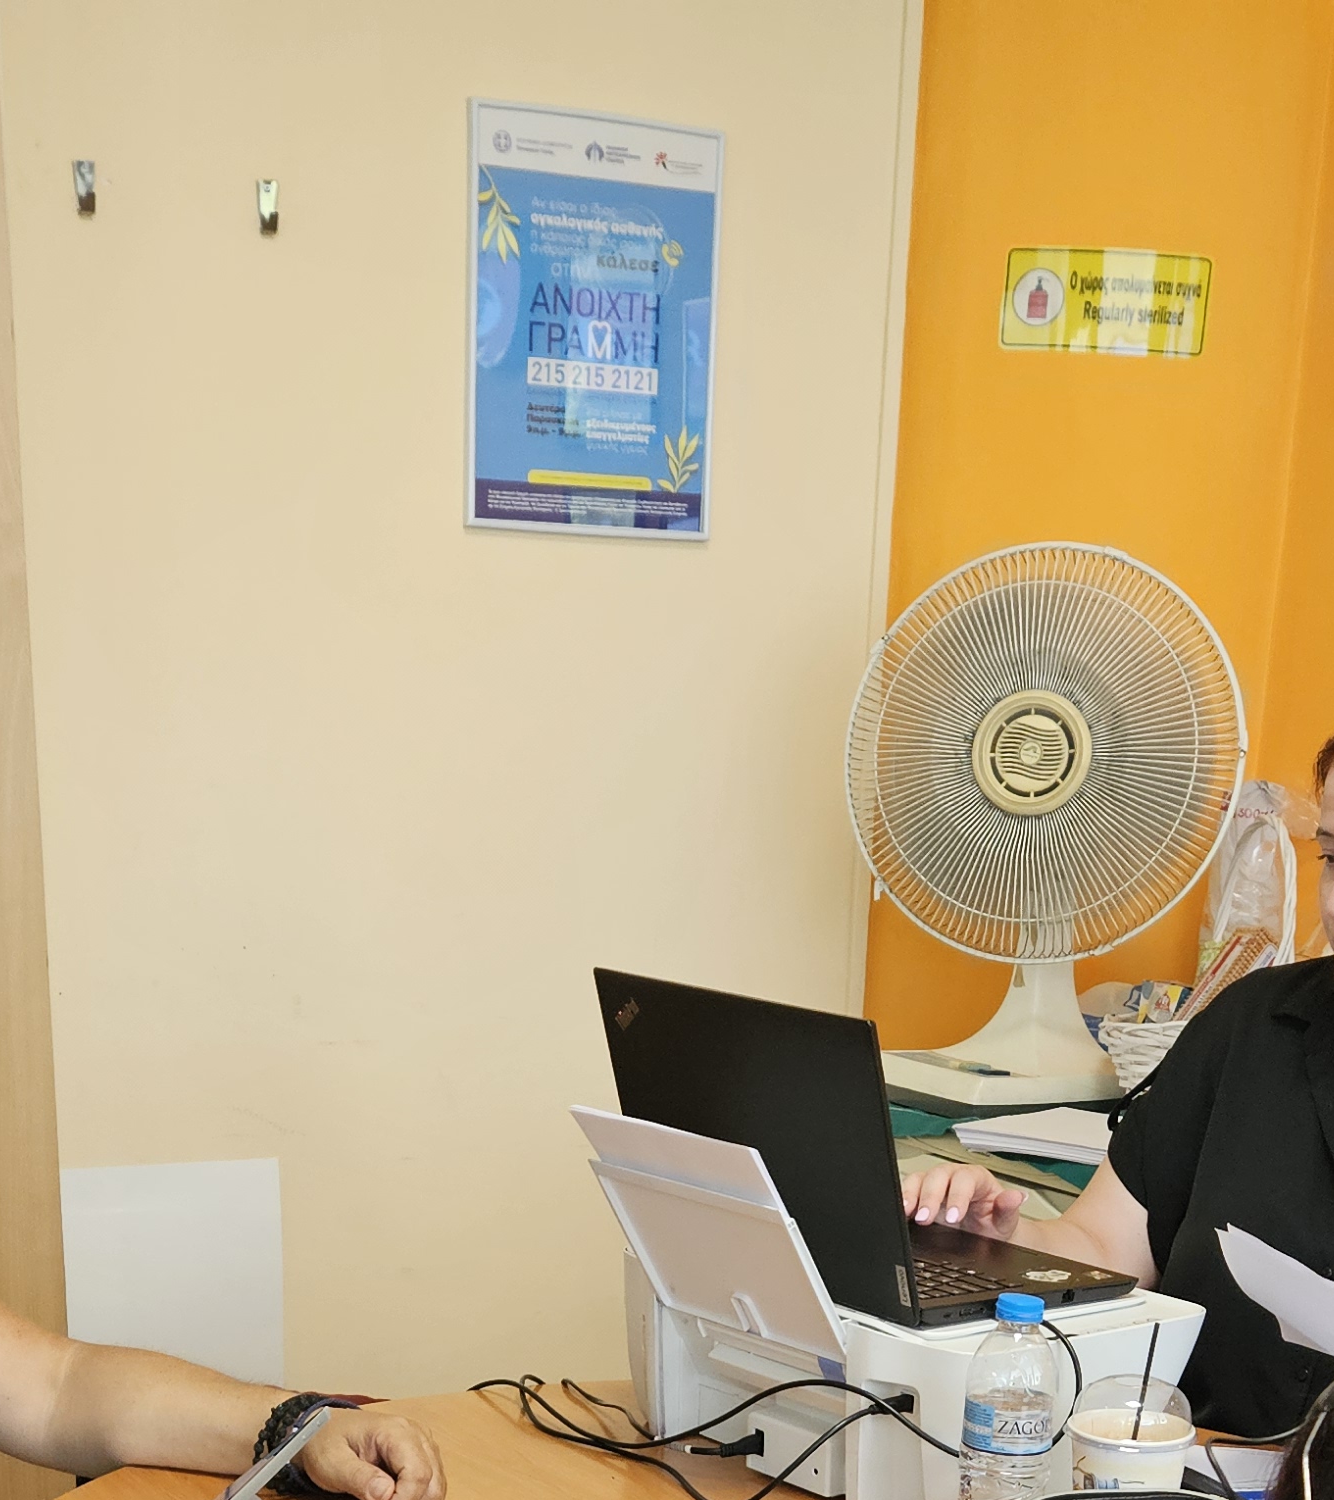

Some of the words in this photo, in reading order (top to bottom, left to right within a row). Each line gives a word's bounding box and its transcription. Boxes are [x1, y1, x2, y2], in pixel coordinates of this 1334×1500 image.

[596, 252, 660, 273] κάλεσε
[1070, 270, 1078, 290] Ο
[1079, 272, 1109, 296] χώρος
[1175, 277, 1202, 301] συχνά
[529, 282, 661, 325] ΑΝΟΙΧΤΗ
[1083, 300, 1135, 327] Regularly
[1137, 304, 1184, 326] sterilized
[529, 320, 660, 364] ΓΡΑΜΜΗ
[531, 361, 566, 384] 215
[572, 364, 605, 388] 215
[611, 368, 653, 392] 2121
